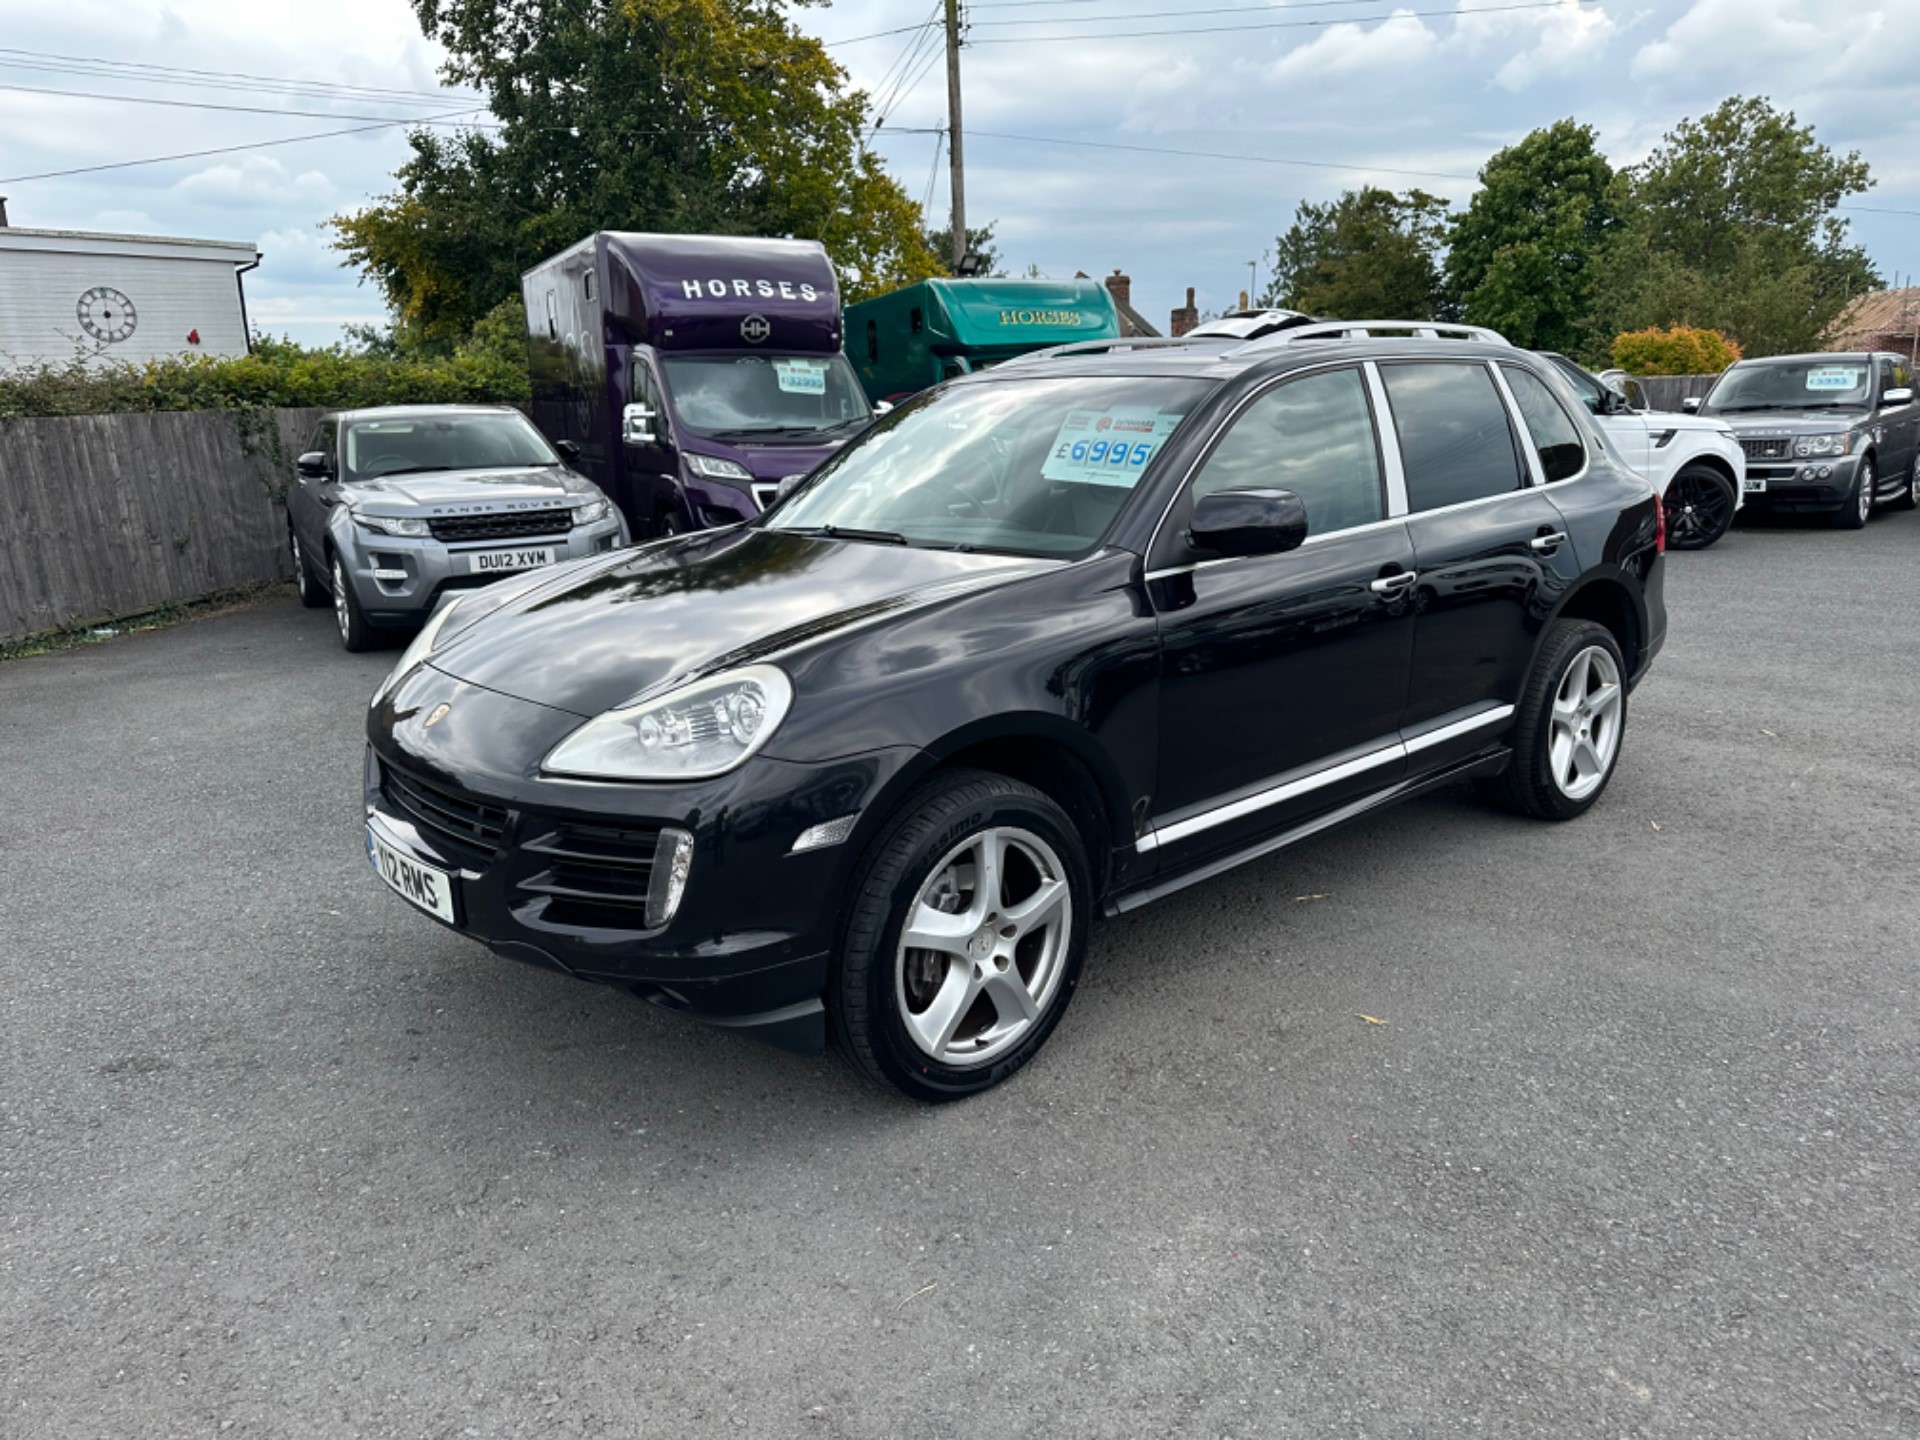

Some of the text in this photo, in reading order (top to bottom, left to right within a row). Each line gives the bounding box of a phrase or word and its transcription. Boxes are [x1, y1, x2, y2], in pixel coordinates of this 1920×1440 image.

[682, 279, 817, 302] HORSES
[999, 310, 1081, 326] HORSES
[433, 500, 563, 514] RANGE ROVER
[478, 553, 513, 569] DU12
[400, 859, 439, 909] RMS
